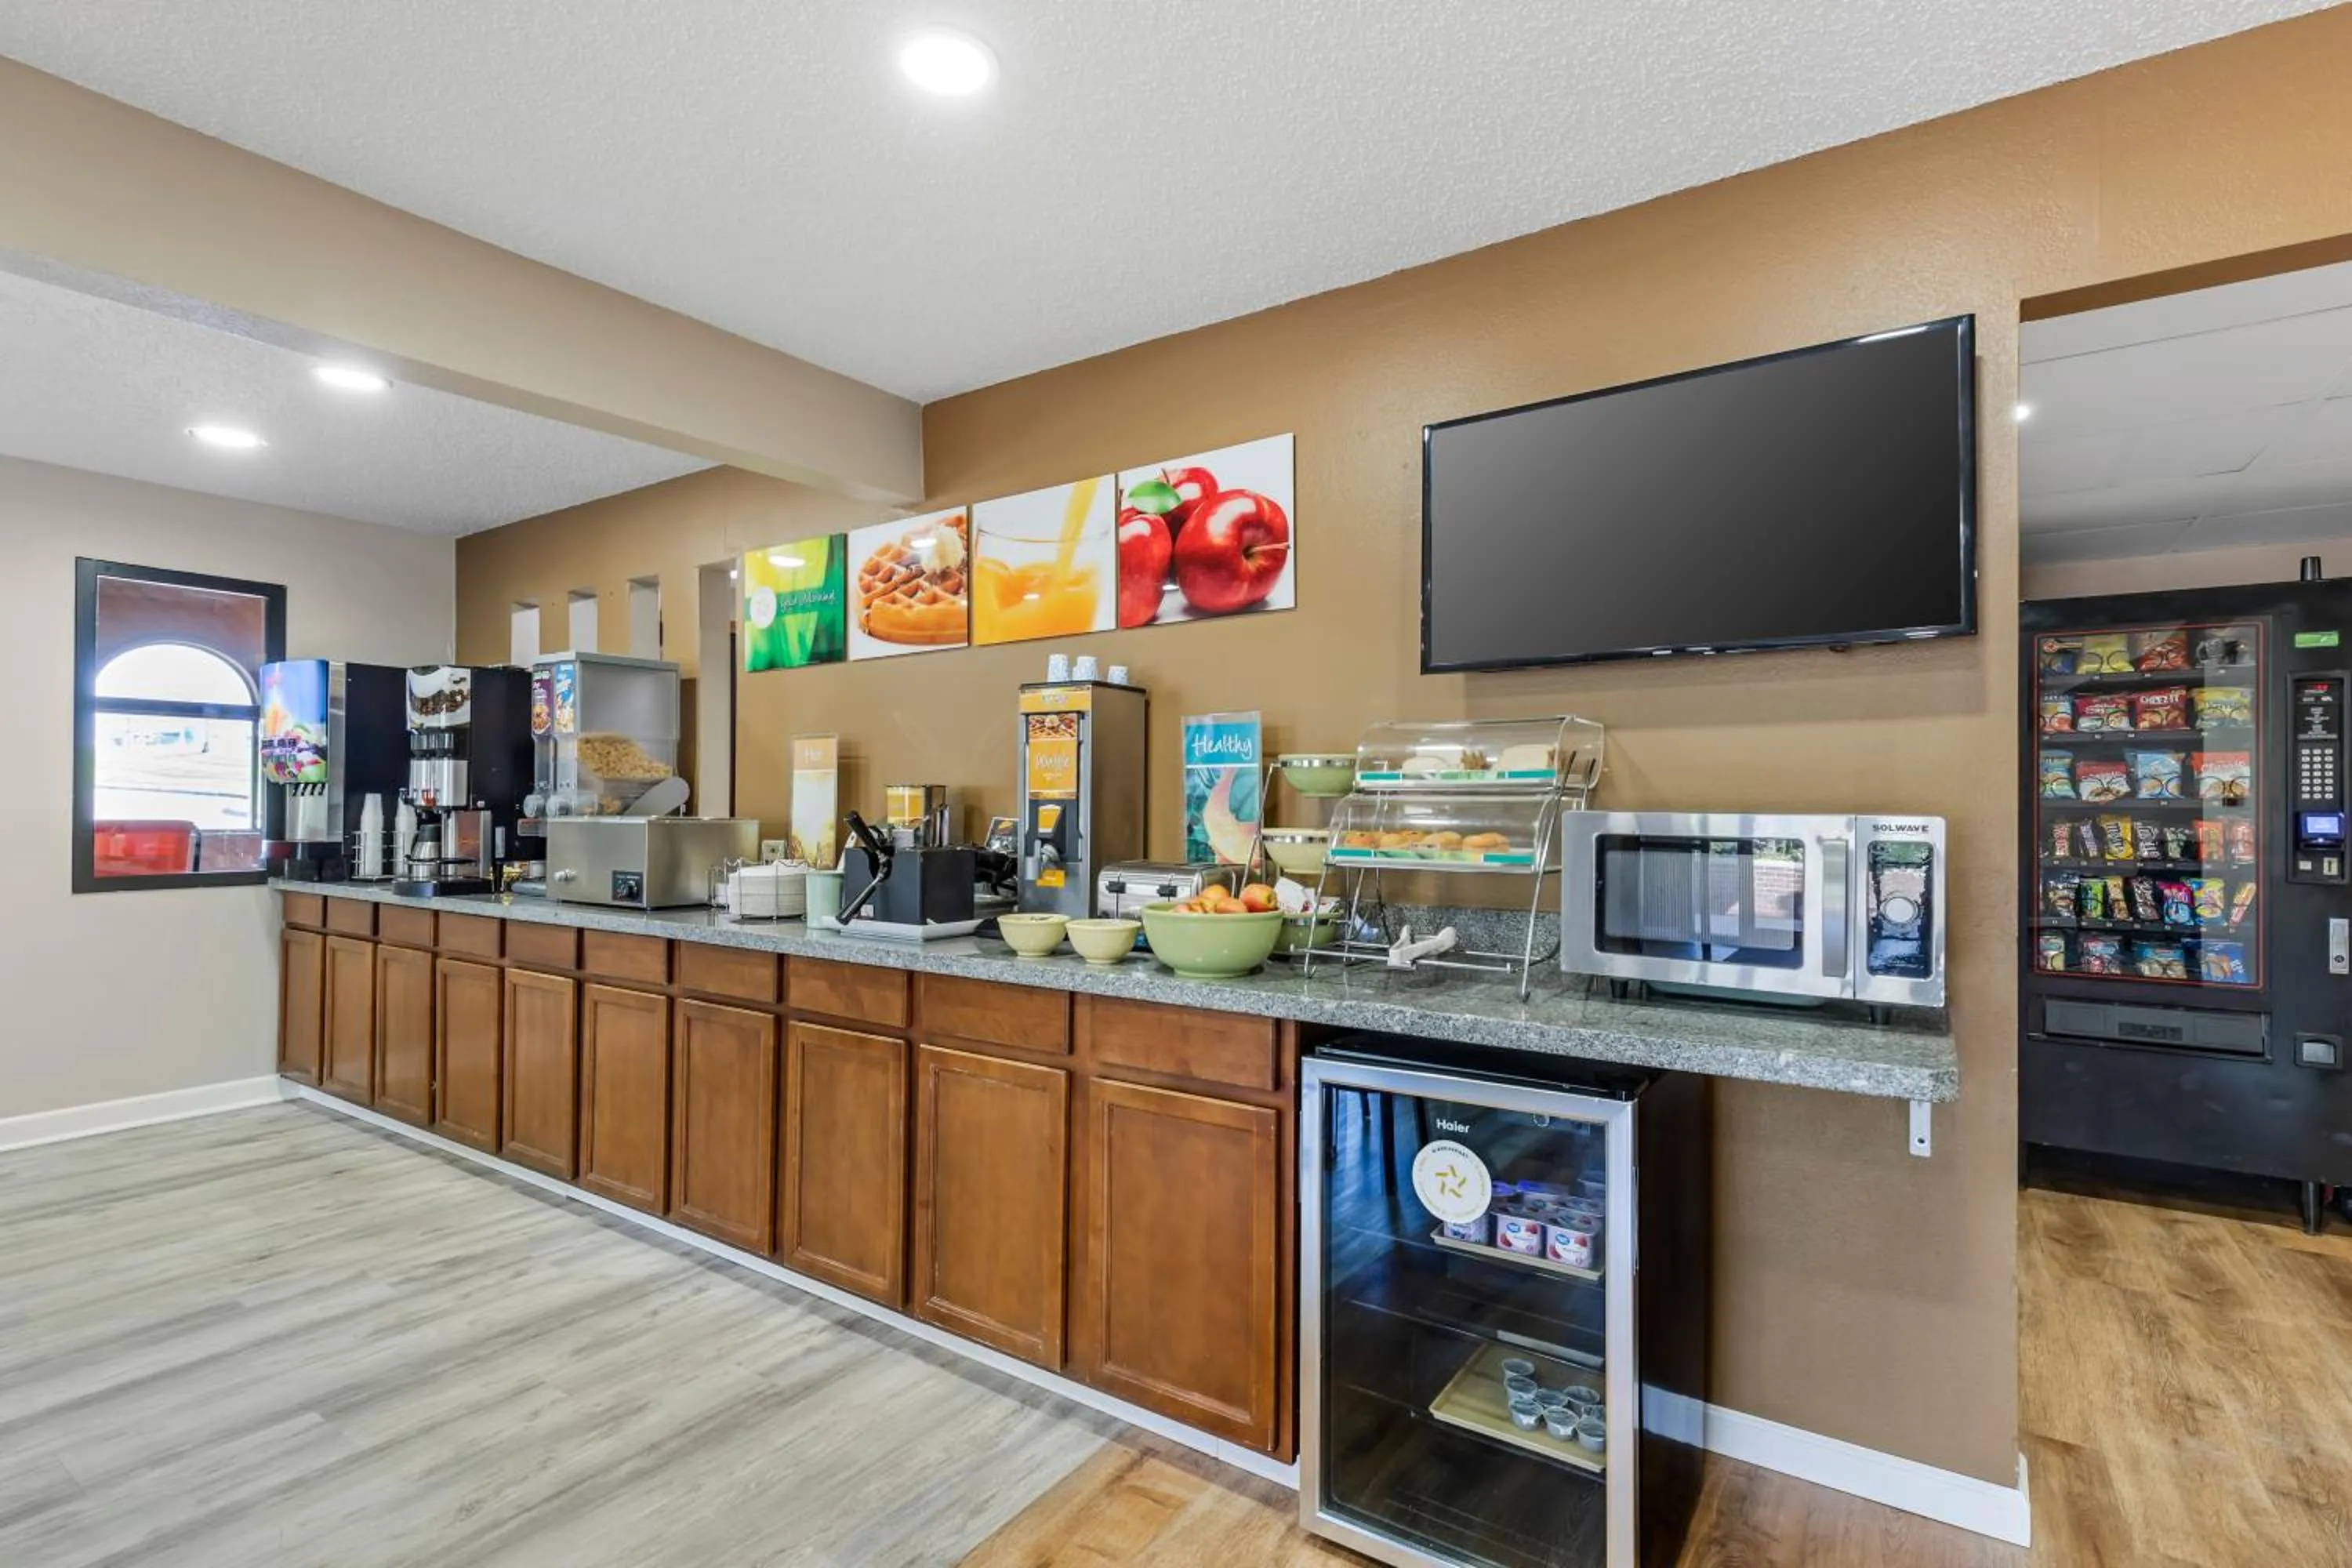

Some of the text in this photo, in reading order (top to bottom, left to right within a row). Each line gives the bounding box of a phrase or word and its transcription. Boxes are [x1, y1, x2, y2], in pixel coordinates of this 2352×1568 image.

[1191, 733, 1253, 760] Healthy
[1872, 824, 1929, 833] SOLWAVE
[1436, 1118, 1471, 1134] Haier
